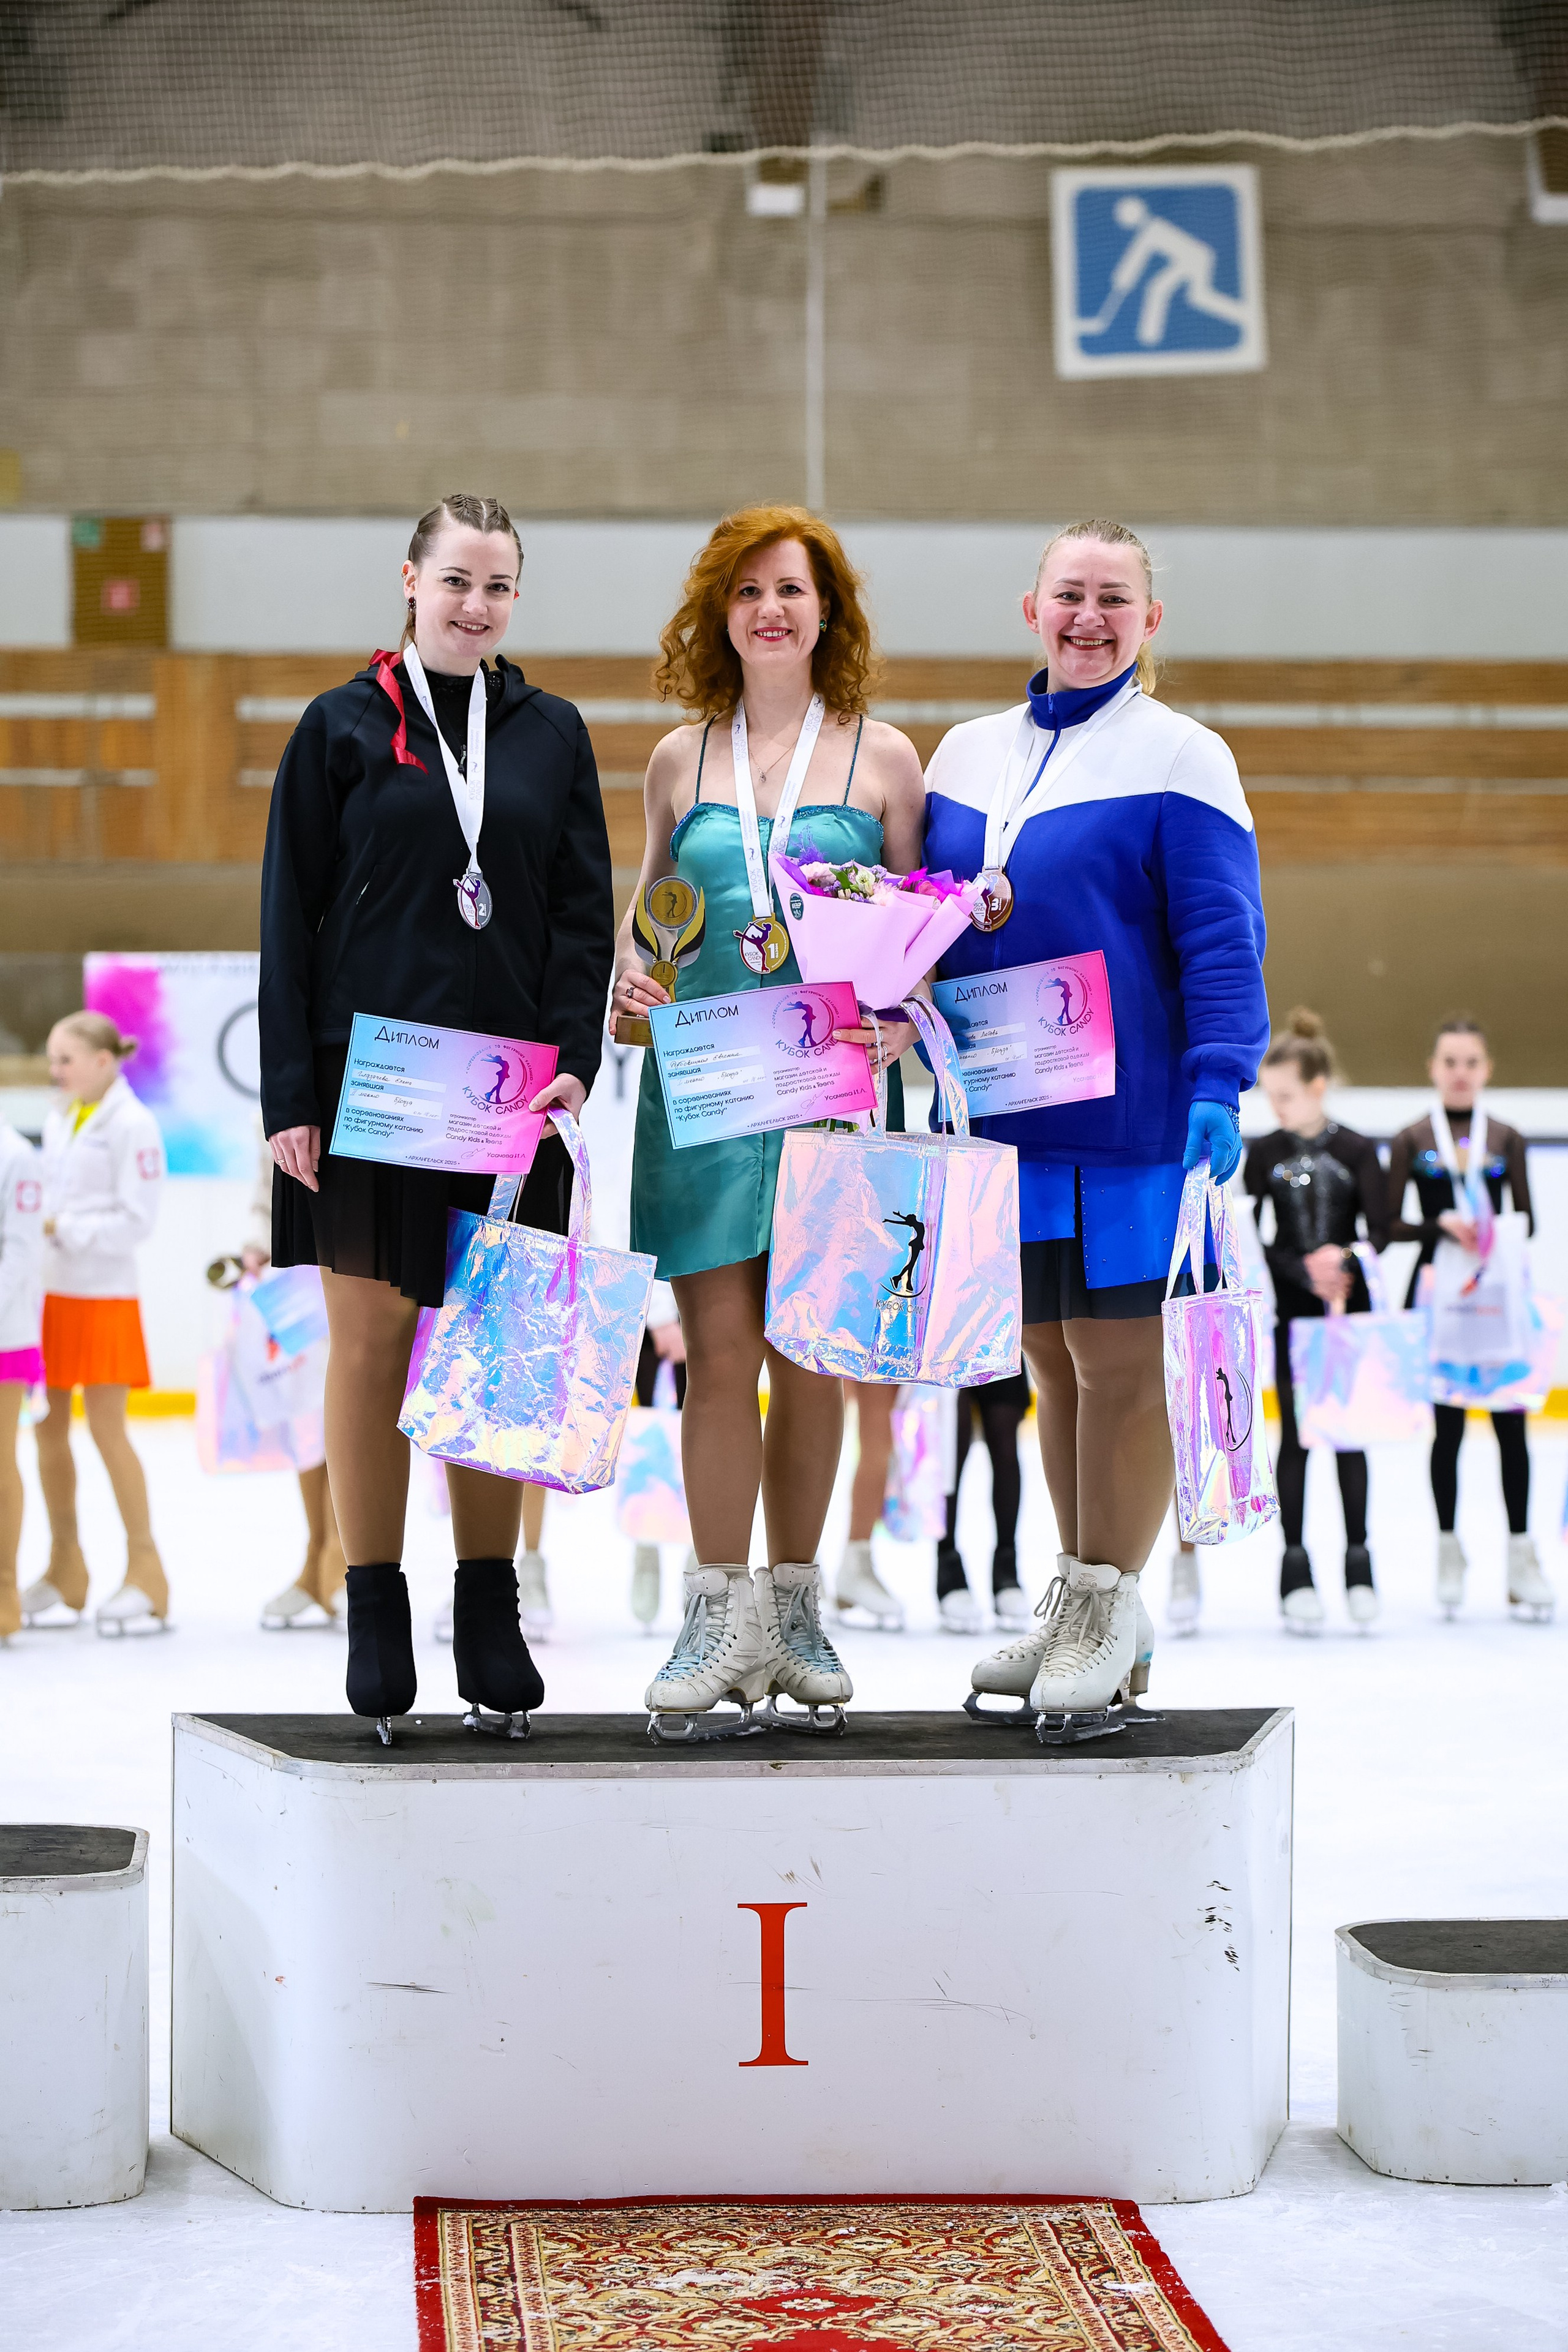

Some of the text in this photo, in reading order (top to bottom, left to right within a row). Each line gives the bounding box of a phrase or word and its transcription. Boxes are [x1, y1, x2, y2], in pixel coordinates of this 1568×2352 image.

[478, 903, 484, 916] 2
[991, 898, 999, 911] 3
[767, 943, 775, 959] 1
[1038, 1007, 1094, 1036] КУБОК CANDY
[663, 1044, 714, 1057] Награждается
[775, 1036, 839, 1058] КУБОК CAND
[1055, 1047, 1076, 1056] детской
[354, 1058, 405, 1072] Награждается
[1035, 1055, 1069, 1066] подростковой
[668, 1068, 701, 1078] занявшая
[799, 1068, 823, 1077] детской
[991, 1072, 1016, 1080] катанию
[1035, 1066, 1053, 1074] Candy
[350, 1080, 384, 1090] занявшая
[775, 1075, 816, 1088] подростковой
[678, 1090, 731, 1104] соревнованиях
[777, 1087, 798, 1096] Candy
[824, 1091, 853, 1101] Усачева
[462, 1086, 529, 1114] КУБОК CANDY
[684, 1099, 724, 1112] фигурному
[725, 1095, 755, 1103] катанию
[351, 1109, 404, 1121] соревнованиях
[353, 1117, 394, 1129] фигурному
[394, 1125, 423, 1133] катанию
[447, 1126, 488, 1136] подростковой
[472, 1122, 497, 1131] детской
[445, 1133, 467, 1142] Candy
[876, 1299, 924, 1315] КУБОК CAND
[737, 1902, 809, 2067] I
